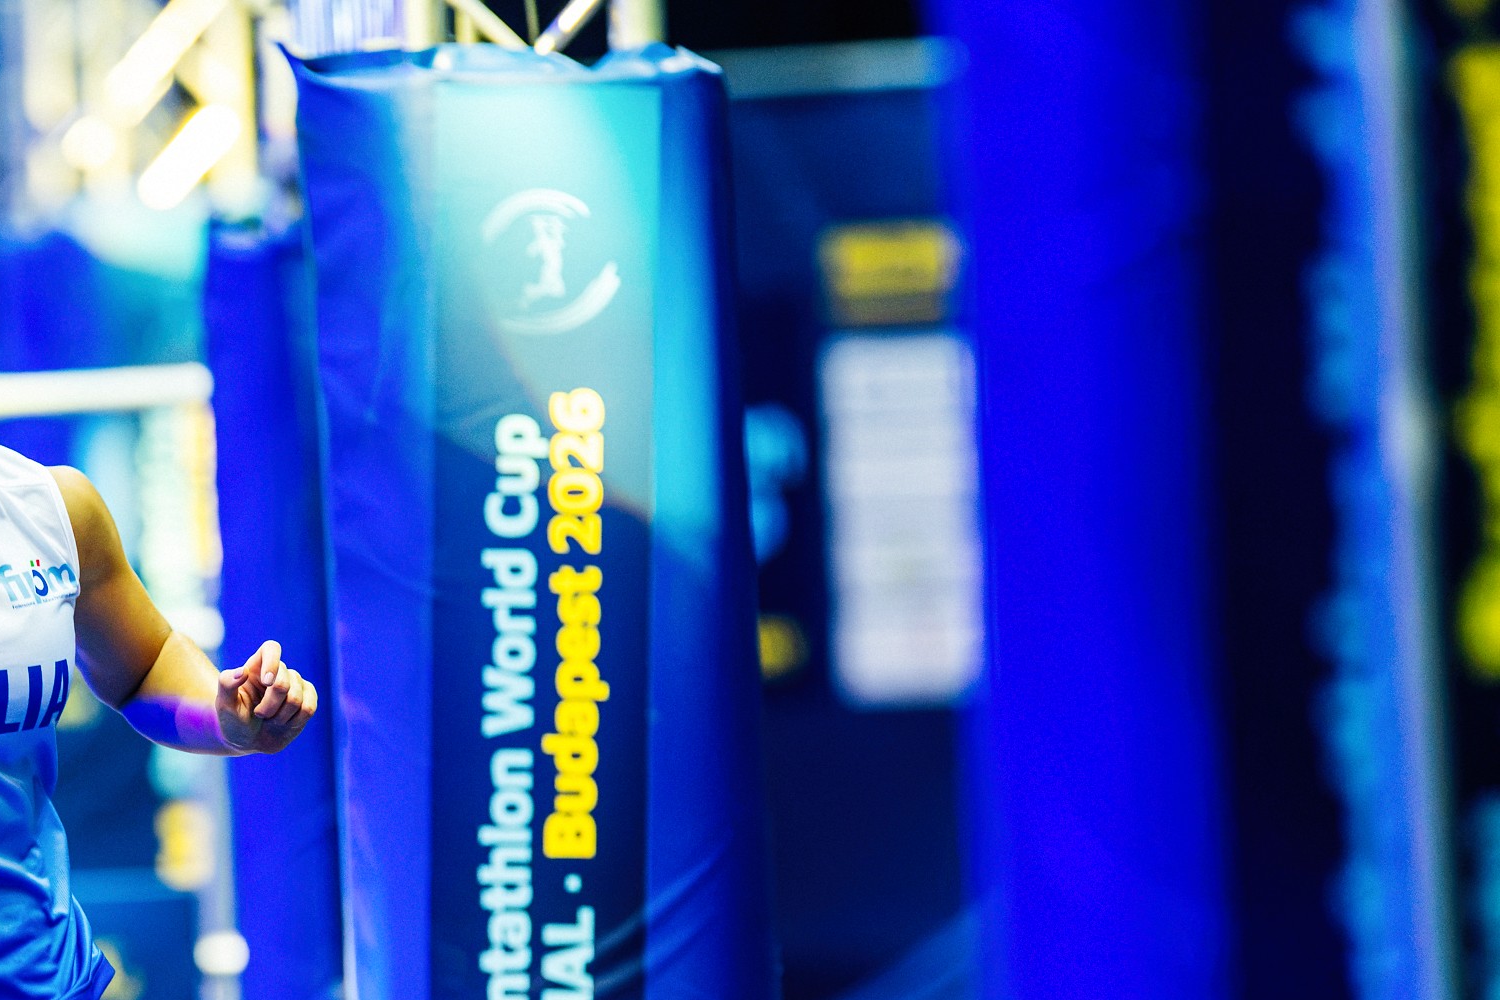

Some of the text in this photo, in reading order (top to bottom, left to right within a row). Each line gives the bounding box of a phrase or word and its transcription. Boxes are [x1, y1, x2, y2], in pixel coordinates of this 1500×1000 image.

[484, 413, 551, 538] Cup
[547, 387, 606, 555] 2026
[480, 547, 540, 738] World
[541, 565, 610, 860] Budapest
